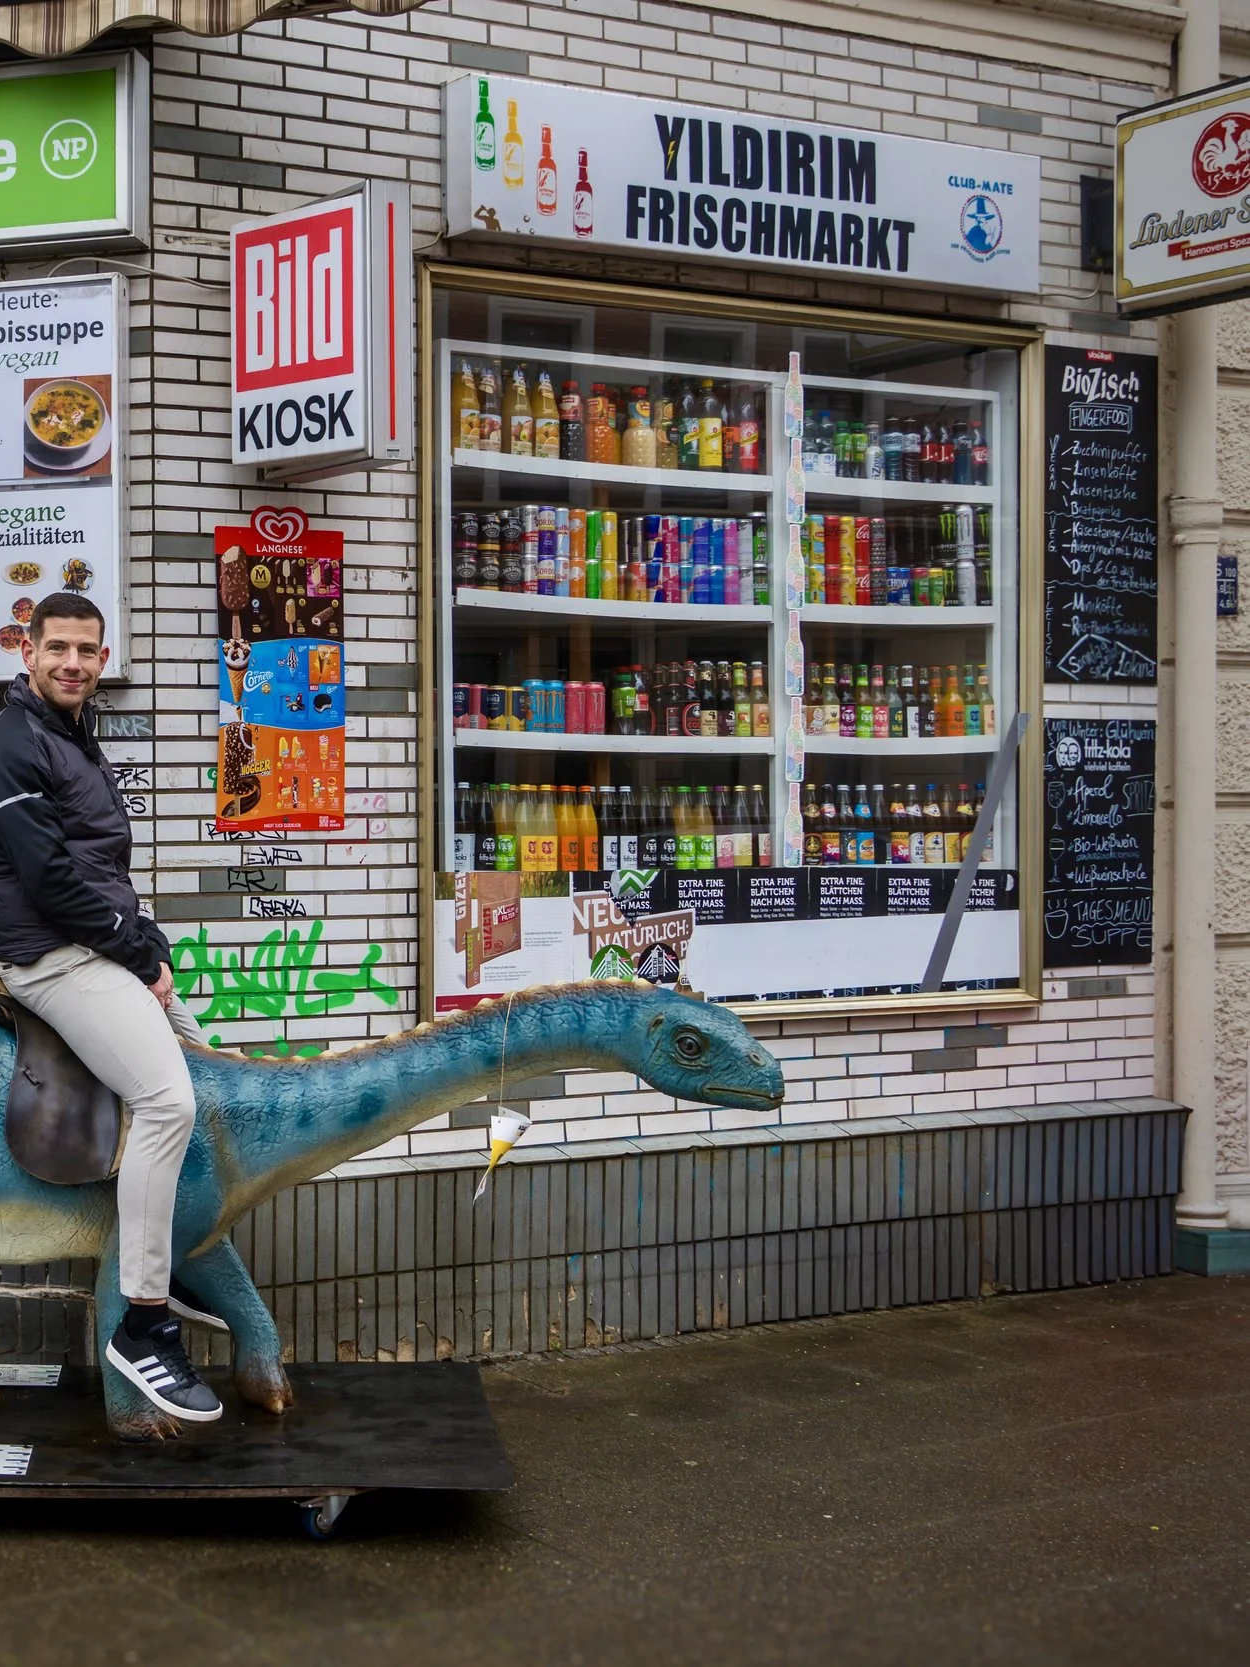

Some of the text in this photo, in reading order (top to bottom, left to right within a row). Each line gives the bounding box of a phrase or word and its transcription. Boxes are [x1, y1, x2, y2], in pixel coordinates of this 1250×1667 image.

[52, 137, 87, 162] NP
[654, 114, 876, 205] YILDIRIM
[948, 175, 1014, 195] CLUB-MATE
[626, 184, 916, 273] FRISCHMARKT
[1129, 206, 1235, 250] Lindener
[1185, 241, 1229, 259] Hannovers
[245, 226, 343, 374] Bild
[239, 389, 354, 452] KIOSK
[1072, 408, 1128, 427] FINGERFOOD
[1072, 440, 1147, 463] Zucchinipuffer
[256, 544, 303, 554] LANGNESE
[255, 569, 267, 580] M
[243, 670, 273, 692] Cornetto
[1084, 738, 1131, 758] fritz-kola
[241, 760, 271, 776] NOGGER
[1084, 761, 1131, 771] vielviel koffein
[678, 879, 725, 888] EXTRA FINE.
[750, 877, 796, 886] EXTRA FINE.
[888, 878, 931, 886] EXTRA FINE.
[678, 888, 723, 898] BLÄTTCHEN
[750, 886, 794, 896] BLÄTTCHEN
[820, 885, 862, 895] BLÄTTCHEN
[888, 886, 929, 896] BLÄTTCHEN
[971, 888, 994, 896] TCHEN
[628, 901, 652, 910] MASS.
[678, 899, 725, 908] NACH MASS.
[750, 898, 796, 907] NACH MASS.
[820, 897, 864, 905] NACH MASS.
[888, 897, 931, 906] NACH MASS.
[975, 898, 996, 906] MASS.
[497, 906, 507, 916] XL
[1072, 897, 1151, 922] TAGESMENÜ
[483, 907, 493, 951] GIZEH
[595, 919, 689, 951] NATÜRLICH:
[1071, 927, 1152, 948] SUPPE
